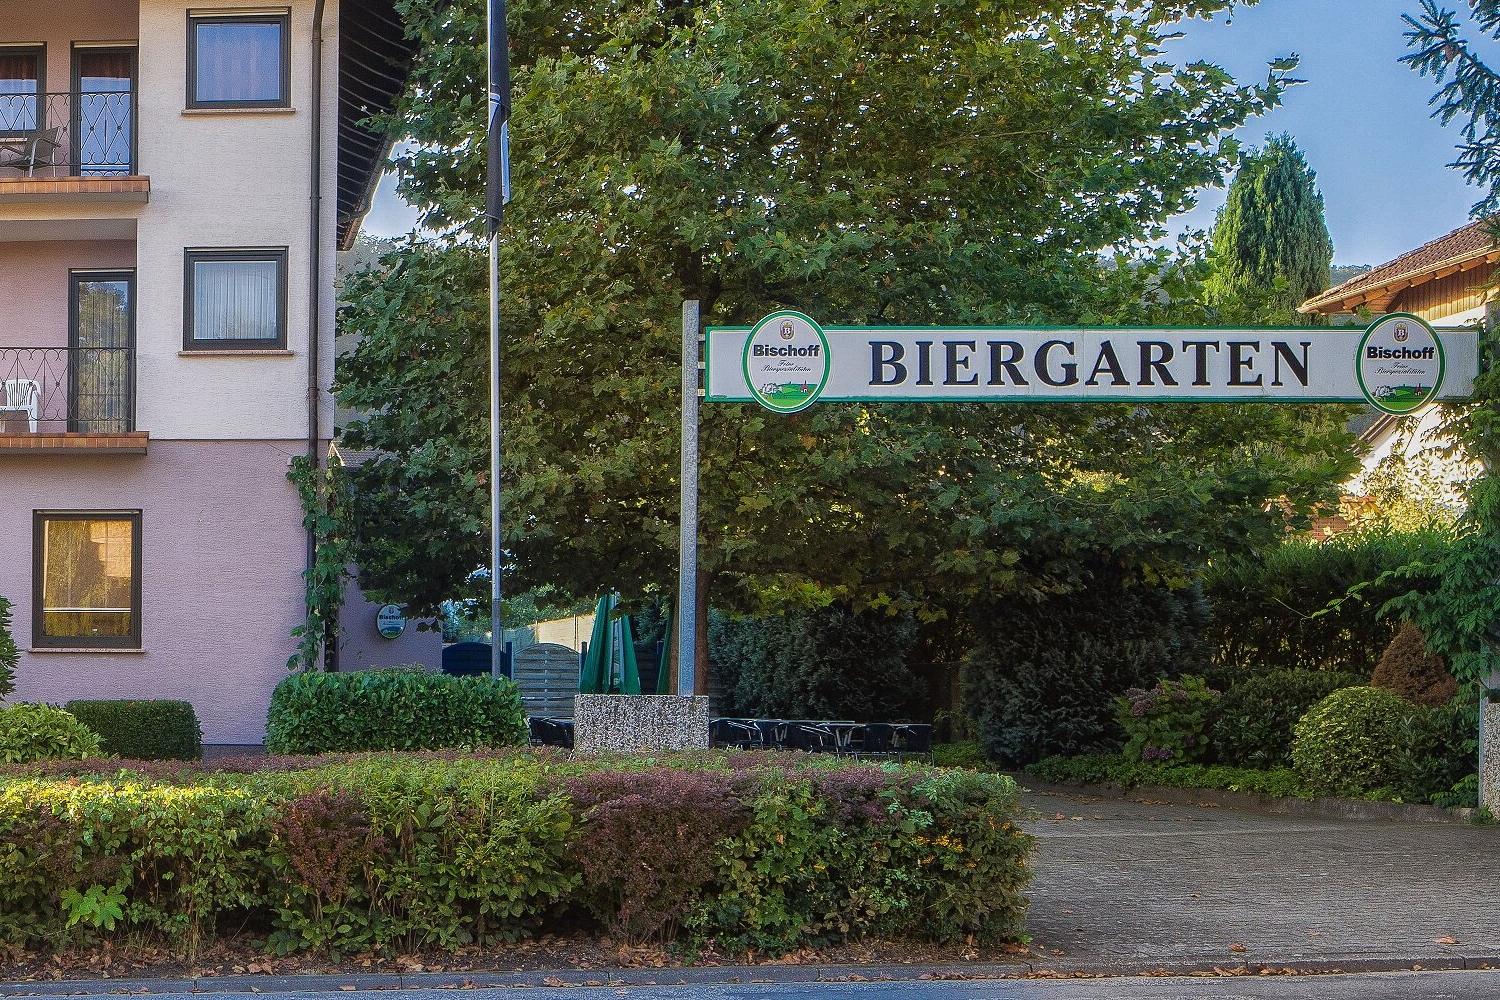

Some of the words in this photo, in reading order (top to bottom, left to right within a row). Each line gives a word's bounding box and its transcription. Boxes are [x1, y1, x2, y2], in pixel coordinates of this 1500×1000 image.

[753, 345, 820, 356] Bischoff
[1366, 346, 1434, 359] Bischoff
[868, 339, 1312, 387] BIERGARTEN
